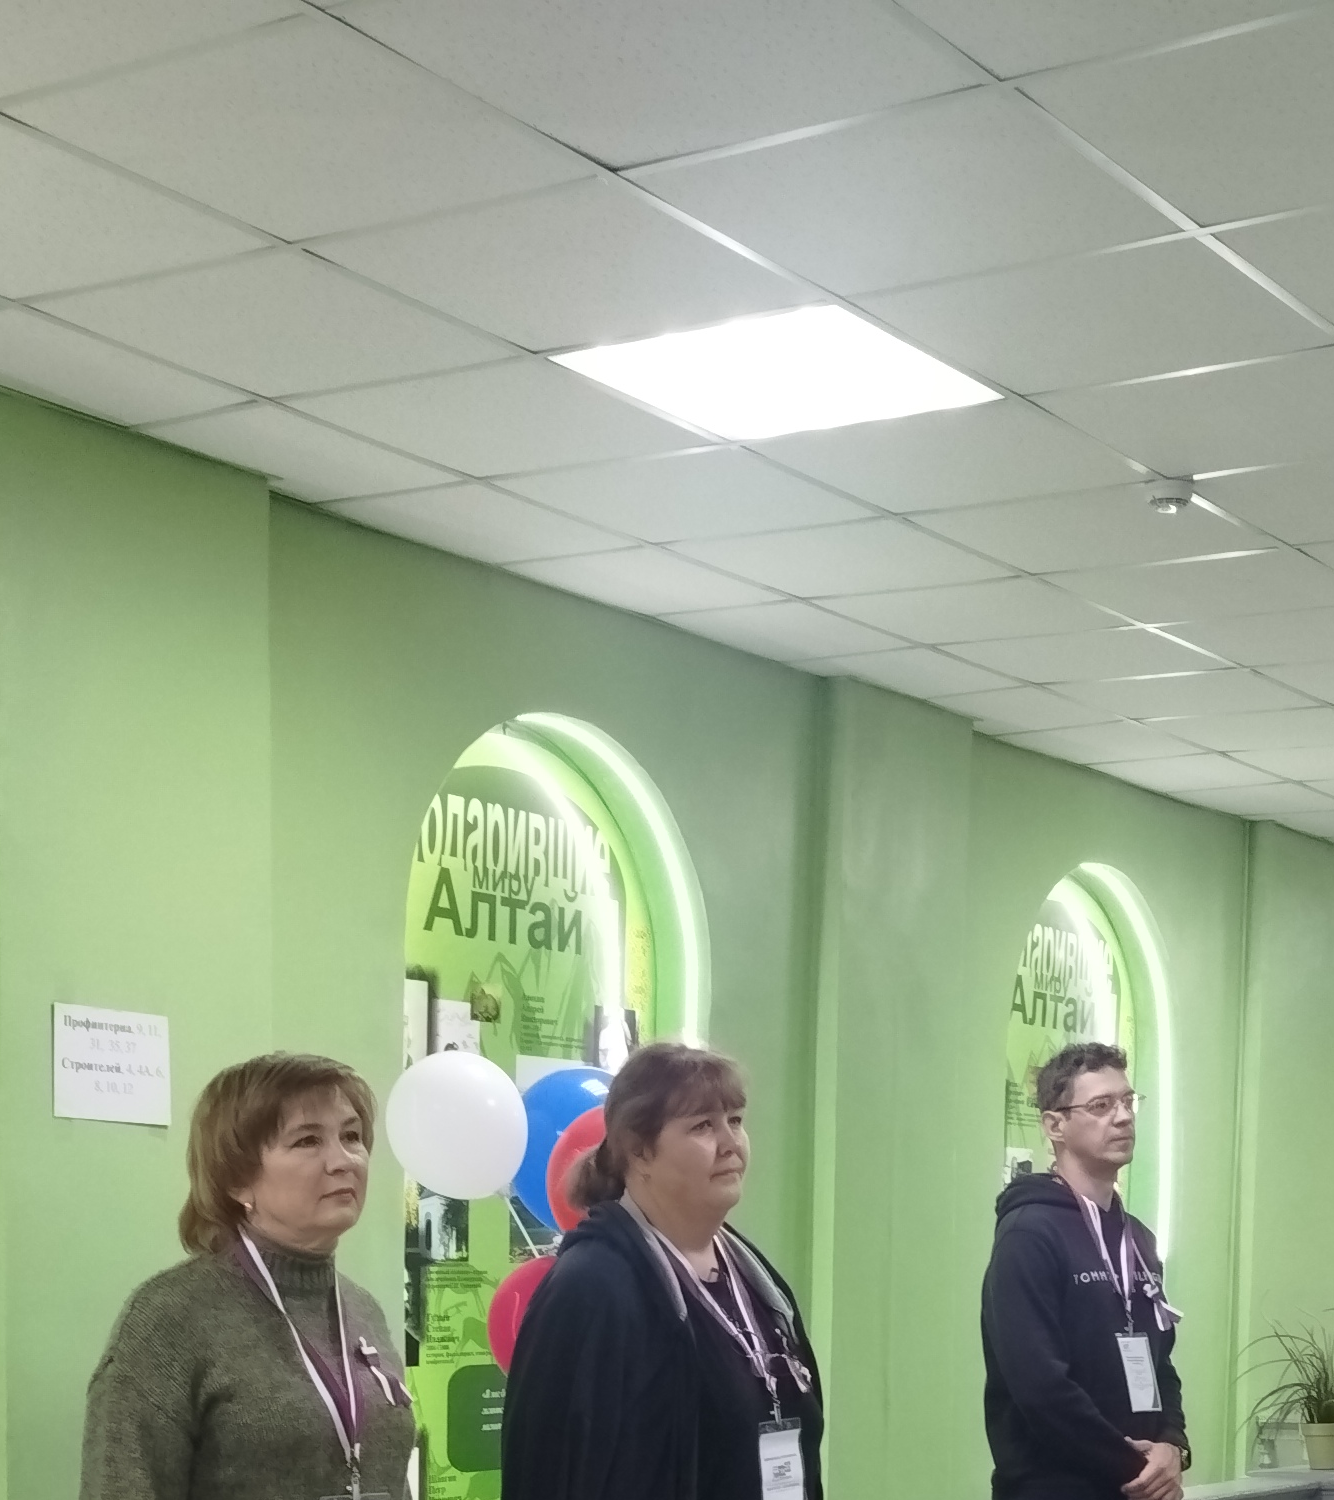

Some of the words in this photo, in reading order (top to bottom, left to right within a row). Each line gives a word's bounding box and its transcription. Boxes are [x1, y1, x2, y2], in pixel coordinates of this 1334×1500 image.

[423, 866, 582, 955] Алтай
[1010, 974, 1096, 1036] Алтай
[1073, 1270, 1113, 1285] TOMM
